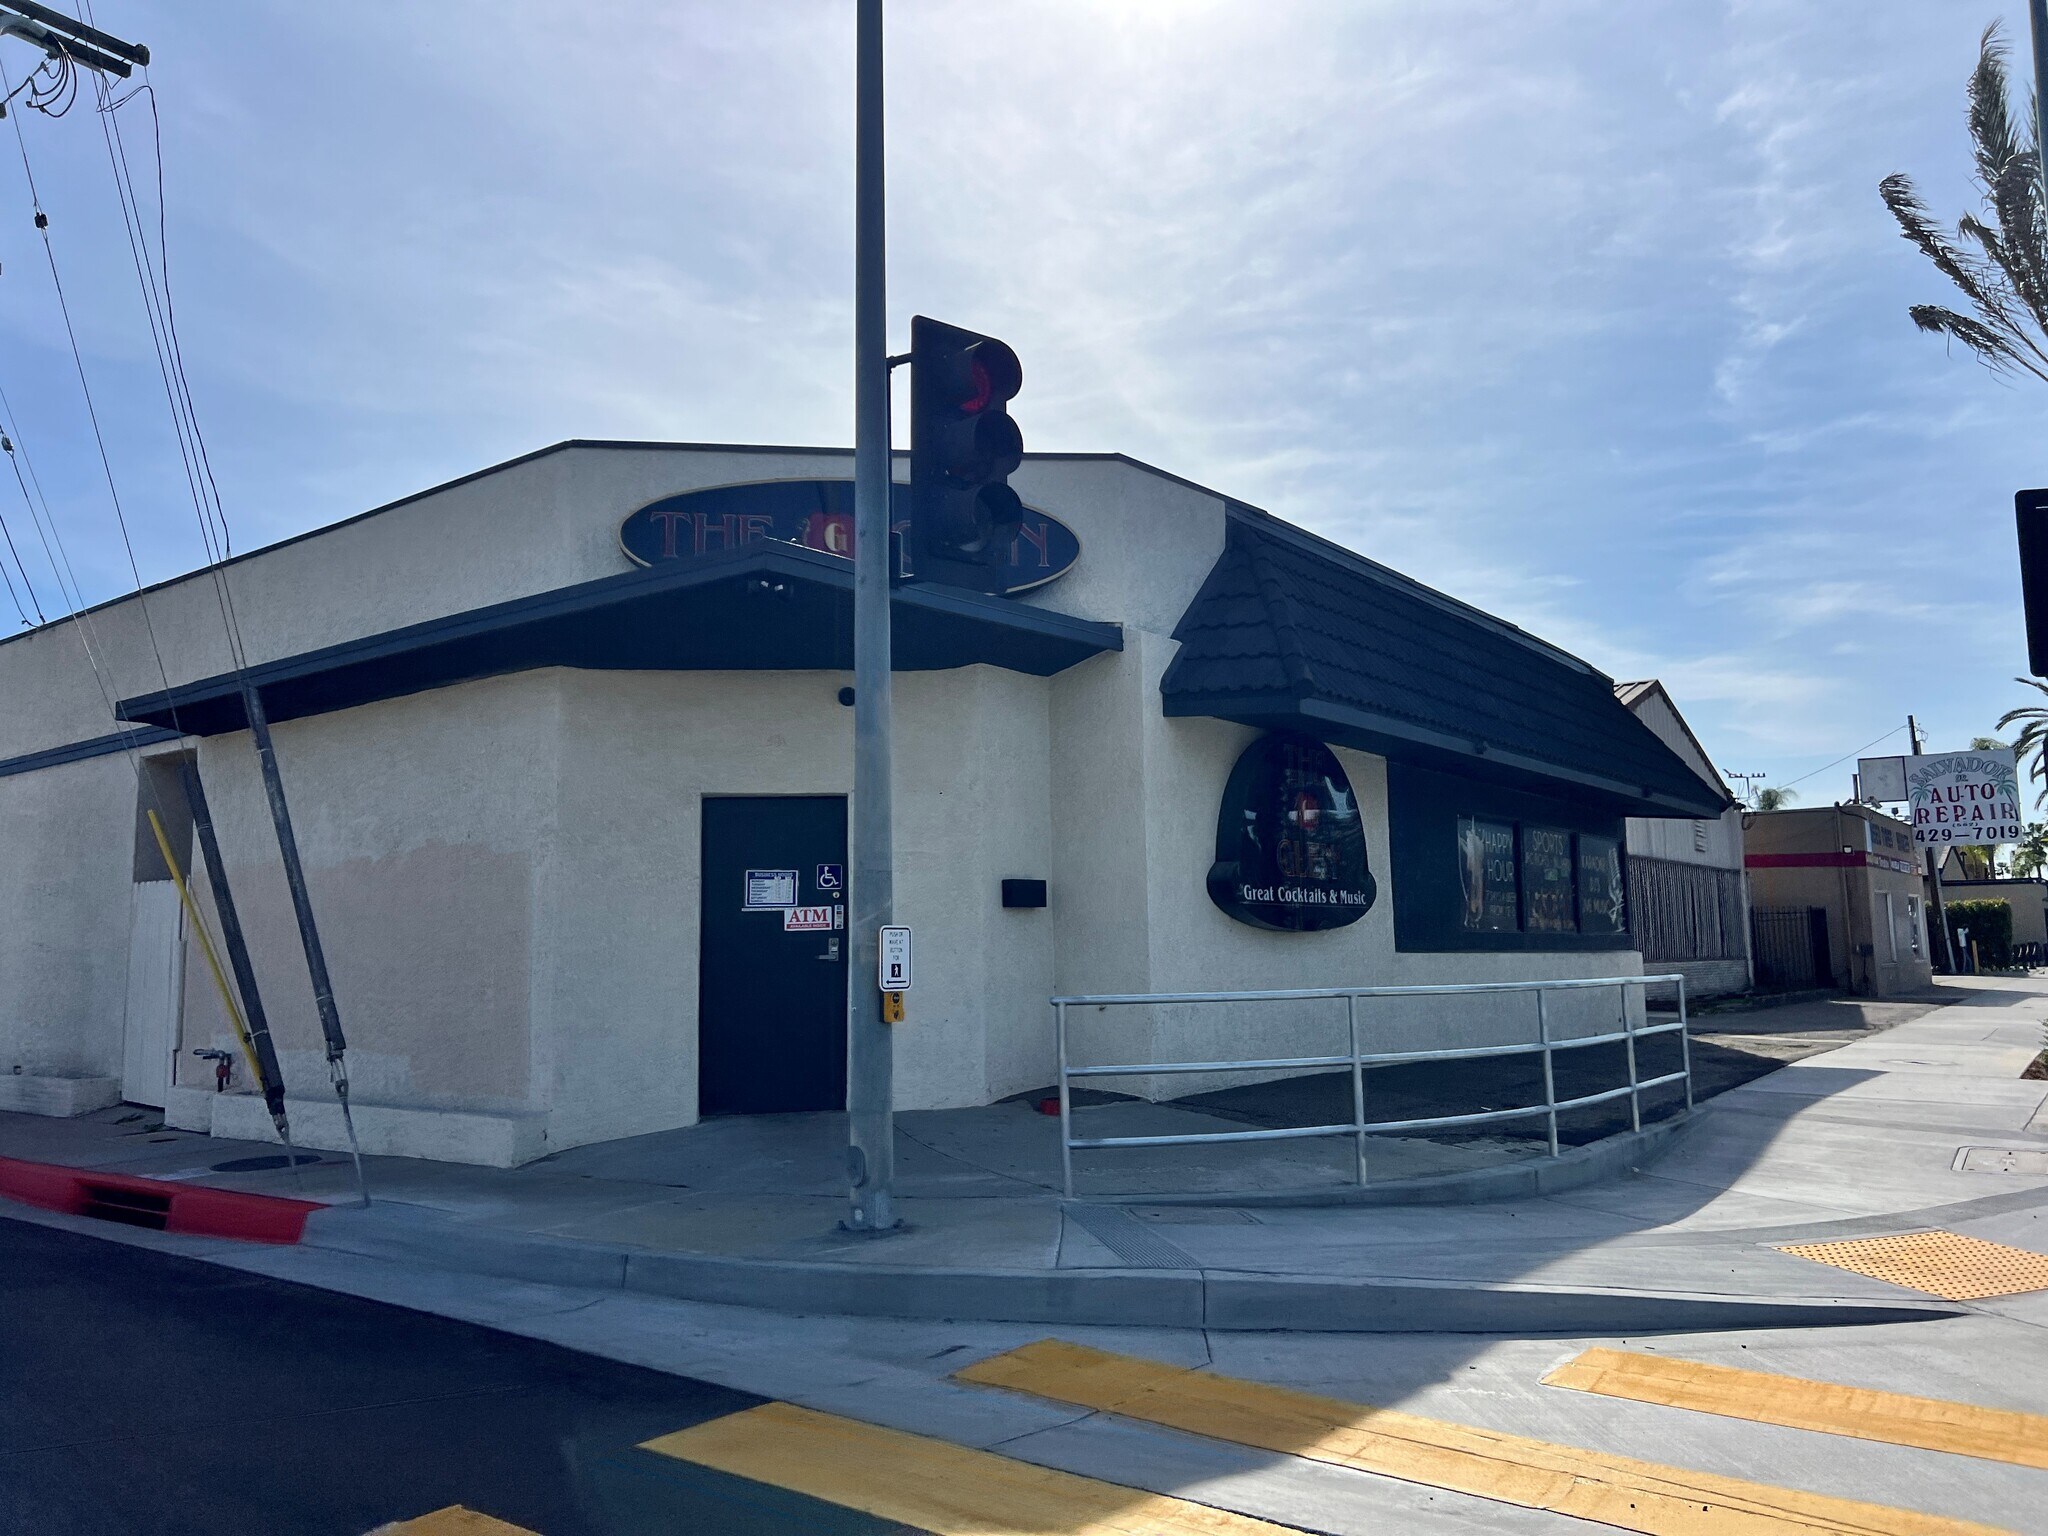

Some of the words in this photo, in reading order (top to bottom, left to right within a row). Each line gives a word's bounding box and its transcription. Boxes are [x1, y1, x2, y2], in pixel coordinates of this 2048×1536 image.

[650, 511, 774, 558] THE
[1908, 756, 2015, 786] SALVADOR
[1930, 782, 1995, 804] AUTO
[1916, 802, 2016, 825] REPAIR
[1485, 829, 1513, 855] HAPPY
[1532, 829, 1564, 855] SPORTS
[1488, 859, 1515, 882] HOUR
[1243, 884, 1275, 902] Great
[1278, 886, 1327, 904] Cocktails
[1329, 889, 1338, 904] &
[1340, 889, 1367, 905] Music
[789, 908, 828, 923] ATM
